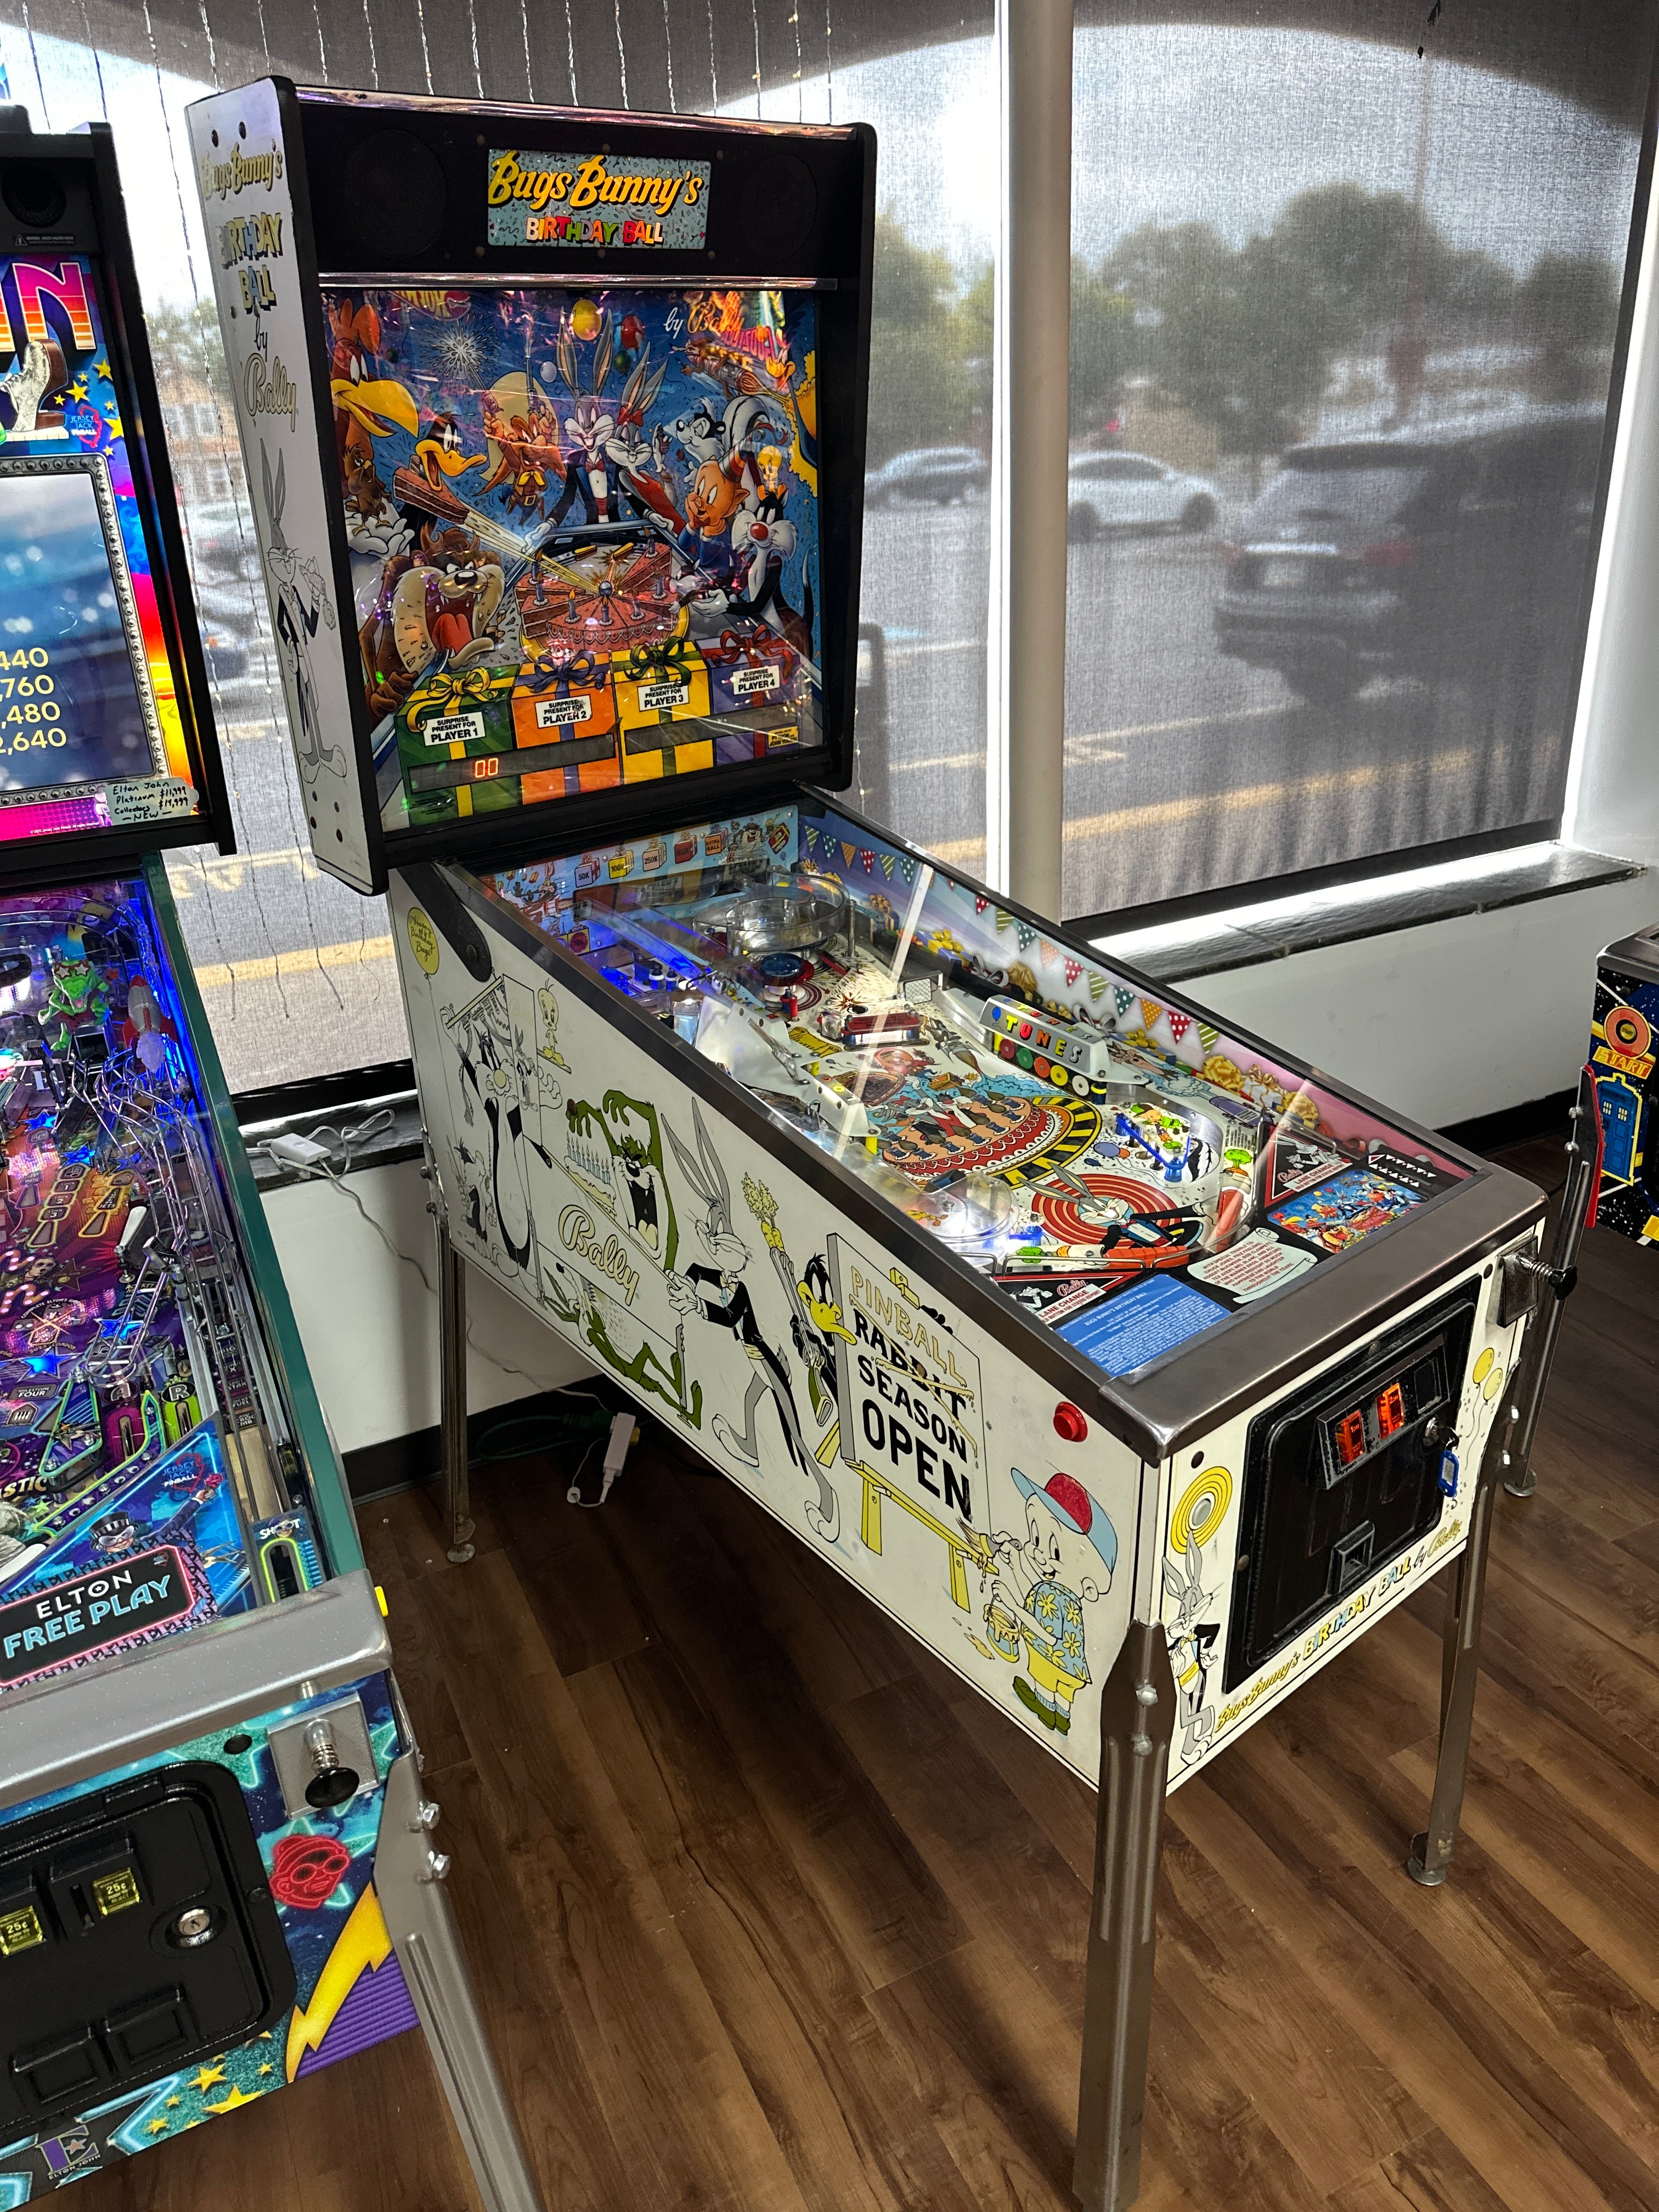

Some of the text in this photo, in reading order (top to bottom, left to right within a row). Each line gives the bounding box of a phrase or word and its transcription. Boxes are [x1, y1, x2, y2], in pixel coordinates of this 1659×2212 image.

[201, 139, 283, 200] Bugs Bunny's
[488, 150, 702, 215] Bugs Bunny's
[526, 216, 664, 245] BIRTHDAY BALL
[216, 212, 283, 269] BIRTHDAY
[239, 265, 276, 314] BALL
[663, 307, 684, 339] by
[254, 317, 268, 362] by
[244, 353, 296, 432] Bally
[71, 415, 94, 424] JERSEY
[739, 674, 763, 683] PRESENT
[743, 668, 769, 677] SURPRISE
[645, 689, 671, 698] PRESENT
[650, 684, 677, 692] SURPRISE
[738, 681, 768, 692] PLAYER
[544, 703, 584, 715] PRESENT FOR
[549, 698, 579, 708] SURPRISE
[644, 696, 677, 708] PLAYER
[2, 701, 60, 729] ,480
[437, 715, 470, 726] SURPRISE
[543, 710, 587, 725] PLAYER 2
[432, 720, 476, 732] PRESENT FOR
[431, 727, 478, 743] PLAYER 1
[112, 785, 139, 795] Elton
[116, 786, 187, 804] Platinum $11,999
[159, 797, 188, 810] $14,999
[644, 854, 658, 865] 250K
[676, 847, 690, 857] 500K
[578, 870, 590, 881] 50K
[610, 863, 625, 873] 100K
[409, 915, 433, 939] Happy
[410, 926, 436, 955] Birthday
[416, 940, 431, 962] Bugs
[1006, 1015, 1083, 1063] TUNES
[1621, 1028, 1633, 1036] START
[1598, 1048, 1649, 1075] START
[1277, 1169, 1304, 1183] Bally
[1294, 1163, 1334, 1184] LANE CHANGE
[558, 1204, 640, 1306] Bally
[1213, 1253, 1231, 1263] SPECIAL
[1229, 1244, 1247, 1254] THANKS
[1057, 1279, 1087, 1296] Bally
[21, 1302, 45, 1319] COMPLETE
[1038, 1290, 1088, 1317] LANE CHANGE
[1096, 1308, 1116, 1319] BUNNY'S
[1114, 1297, 1137, 1310] BIRTHDAY
[850, 1265, 967, 1387] PINBALL
[52, 1342, 77, 1351] LONDON
[853, 1308, 967, 1421] RABBIT
[110, 1383, 189, 1401] A R
[232, 1400, 250, 1408] FUEL
[857, 1355, 968, 1464] SEASON
[162, 1460, 195, 1476] JERSEY
[862, 1398, 972, 1523] OPEN
[163, 1474, 198, 1487] PINBALL
[169, 1468, 193, 1480] JACK
[36, 1570, 133, 1619] ELTON
[4, 1575, 171, 1658] FREE PLAY
[1214, 1519, 1463, 1733] Bugs Bunny's BIRTHDAY BALL by Bally
[106, 1882, 127, 1894] 25¢
[6, 1921, 28, 1934] 25¢
[35, 2124, 99, 2175] E
[48, 2153, 101, 2180] ELTON JOHN
